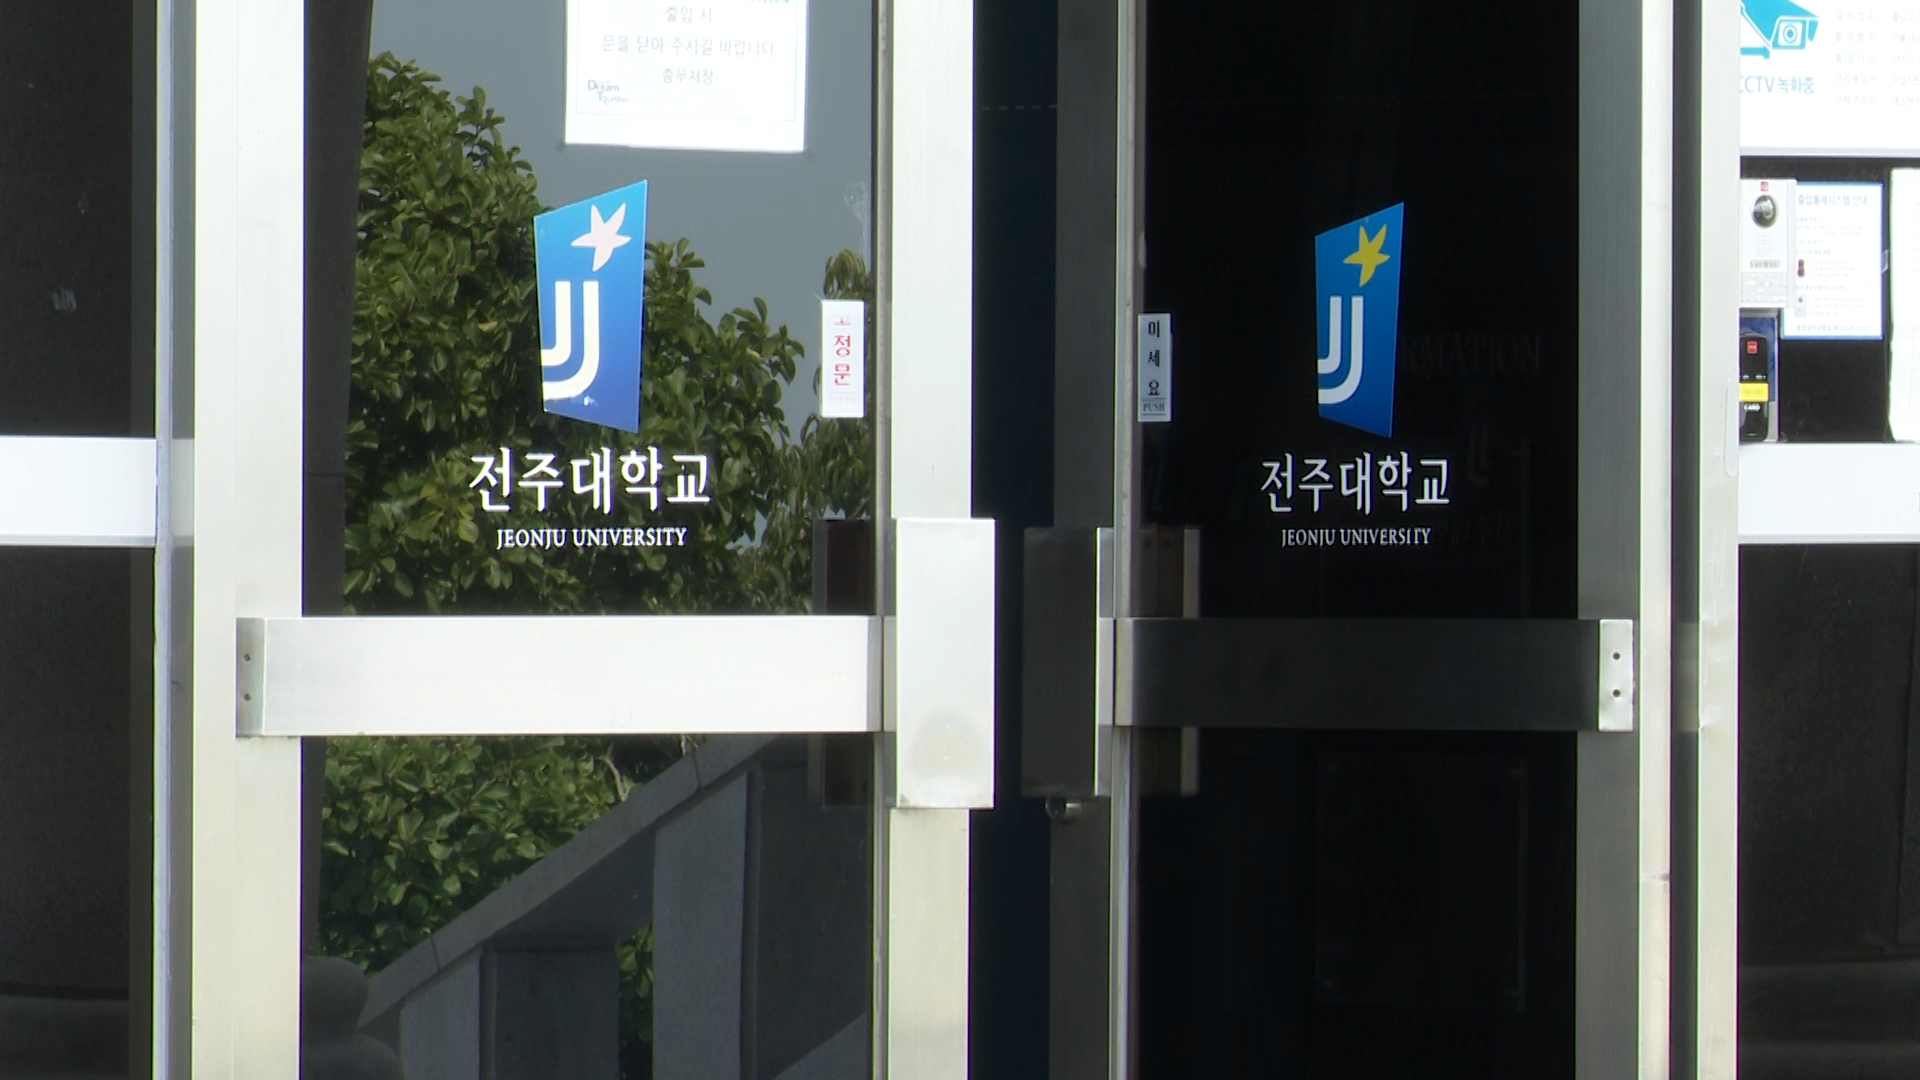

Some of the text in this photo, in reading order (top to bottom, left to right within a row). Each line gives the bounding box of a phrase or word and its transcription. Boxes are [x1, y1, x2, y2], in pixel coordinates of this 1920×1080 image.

[665, 6, 713, 23] 출입 시
[602, 35, 630, 53] 문을
[636, 36, 665, 54] 닫아
[670, 37, 713, 56] 주시길
[1740, 75, 1815, 95] CTV 녹화중
[1143, 403, 1165, 412] PUSH
[469, 445, 711, 515] 전주대학교
[1260, 451, 1450, 516] 전주대학교
[496, 527, 688, 550] JEONJU UNIVERSITY
[1281, 528, 1336, 548] JEONJU
[1339, 527, 1432, 546] UNIVERSITY
